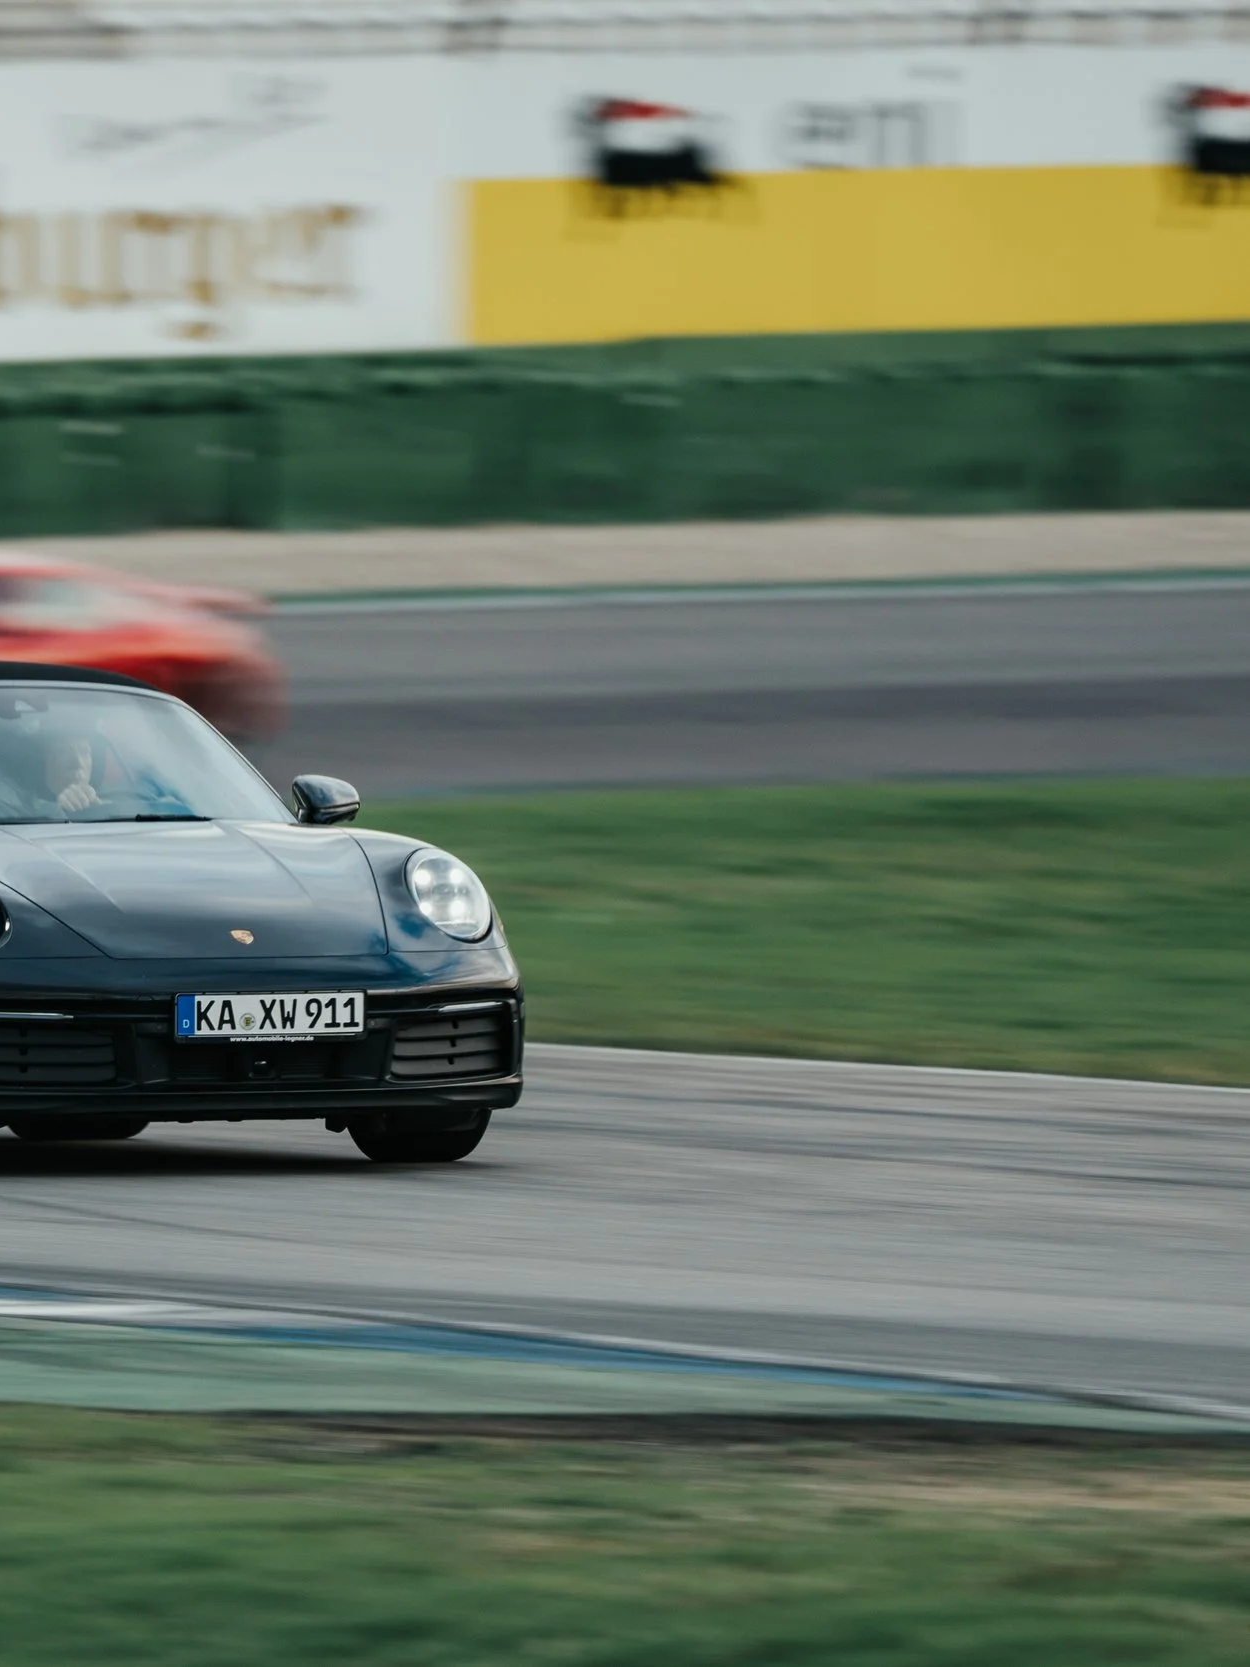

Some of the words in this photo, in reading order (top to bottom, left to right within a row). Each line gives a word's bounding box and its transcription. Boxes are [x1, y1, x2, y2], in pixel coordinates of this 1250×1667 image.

[182, 1018, 190, 1029] D
[196, 999, 237, 1031] KA
[258, 998, 298, 1030] XW
[304, 996, 360, 1029] 911
